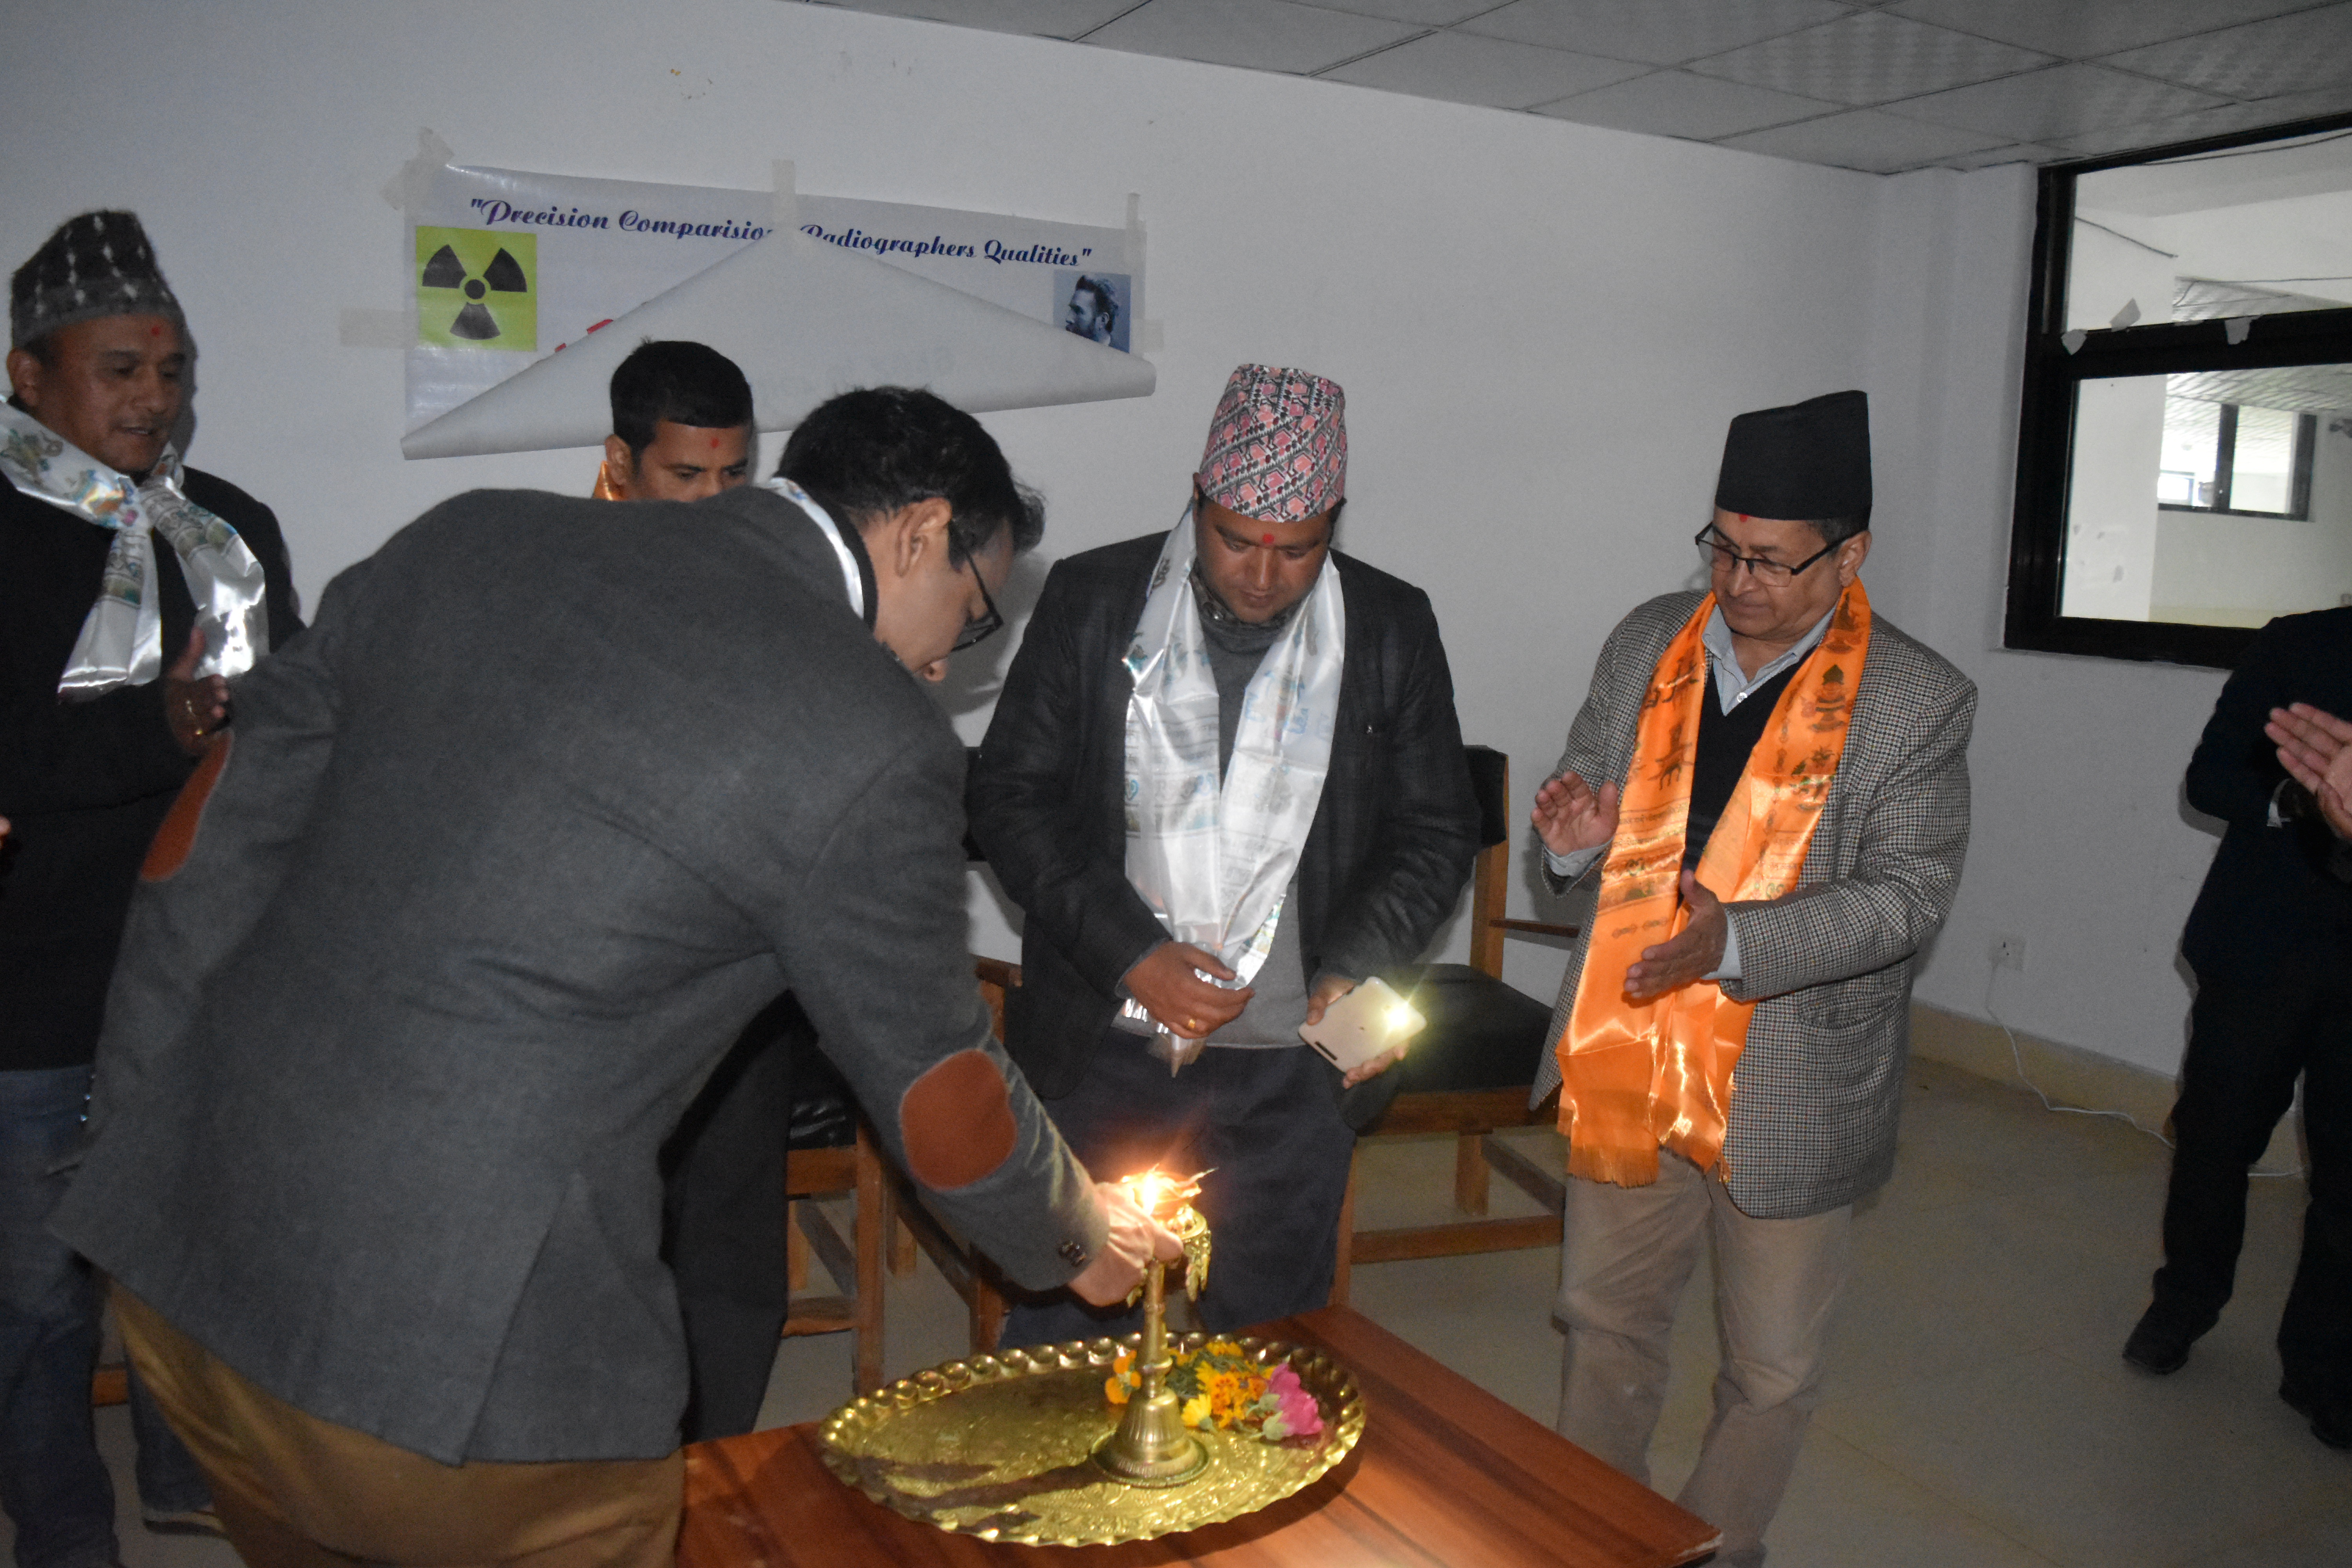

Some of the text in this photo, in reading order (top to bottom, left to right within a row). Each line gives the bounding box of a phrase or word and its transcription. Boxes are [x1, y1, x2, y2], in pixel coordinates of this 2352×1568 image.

[471, 198, 611, 229] "Precision
[618, 210, 773, 240] Comparisio
[984, 239, 1092, 266] Qualities"
